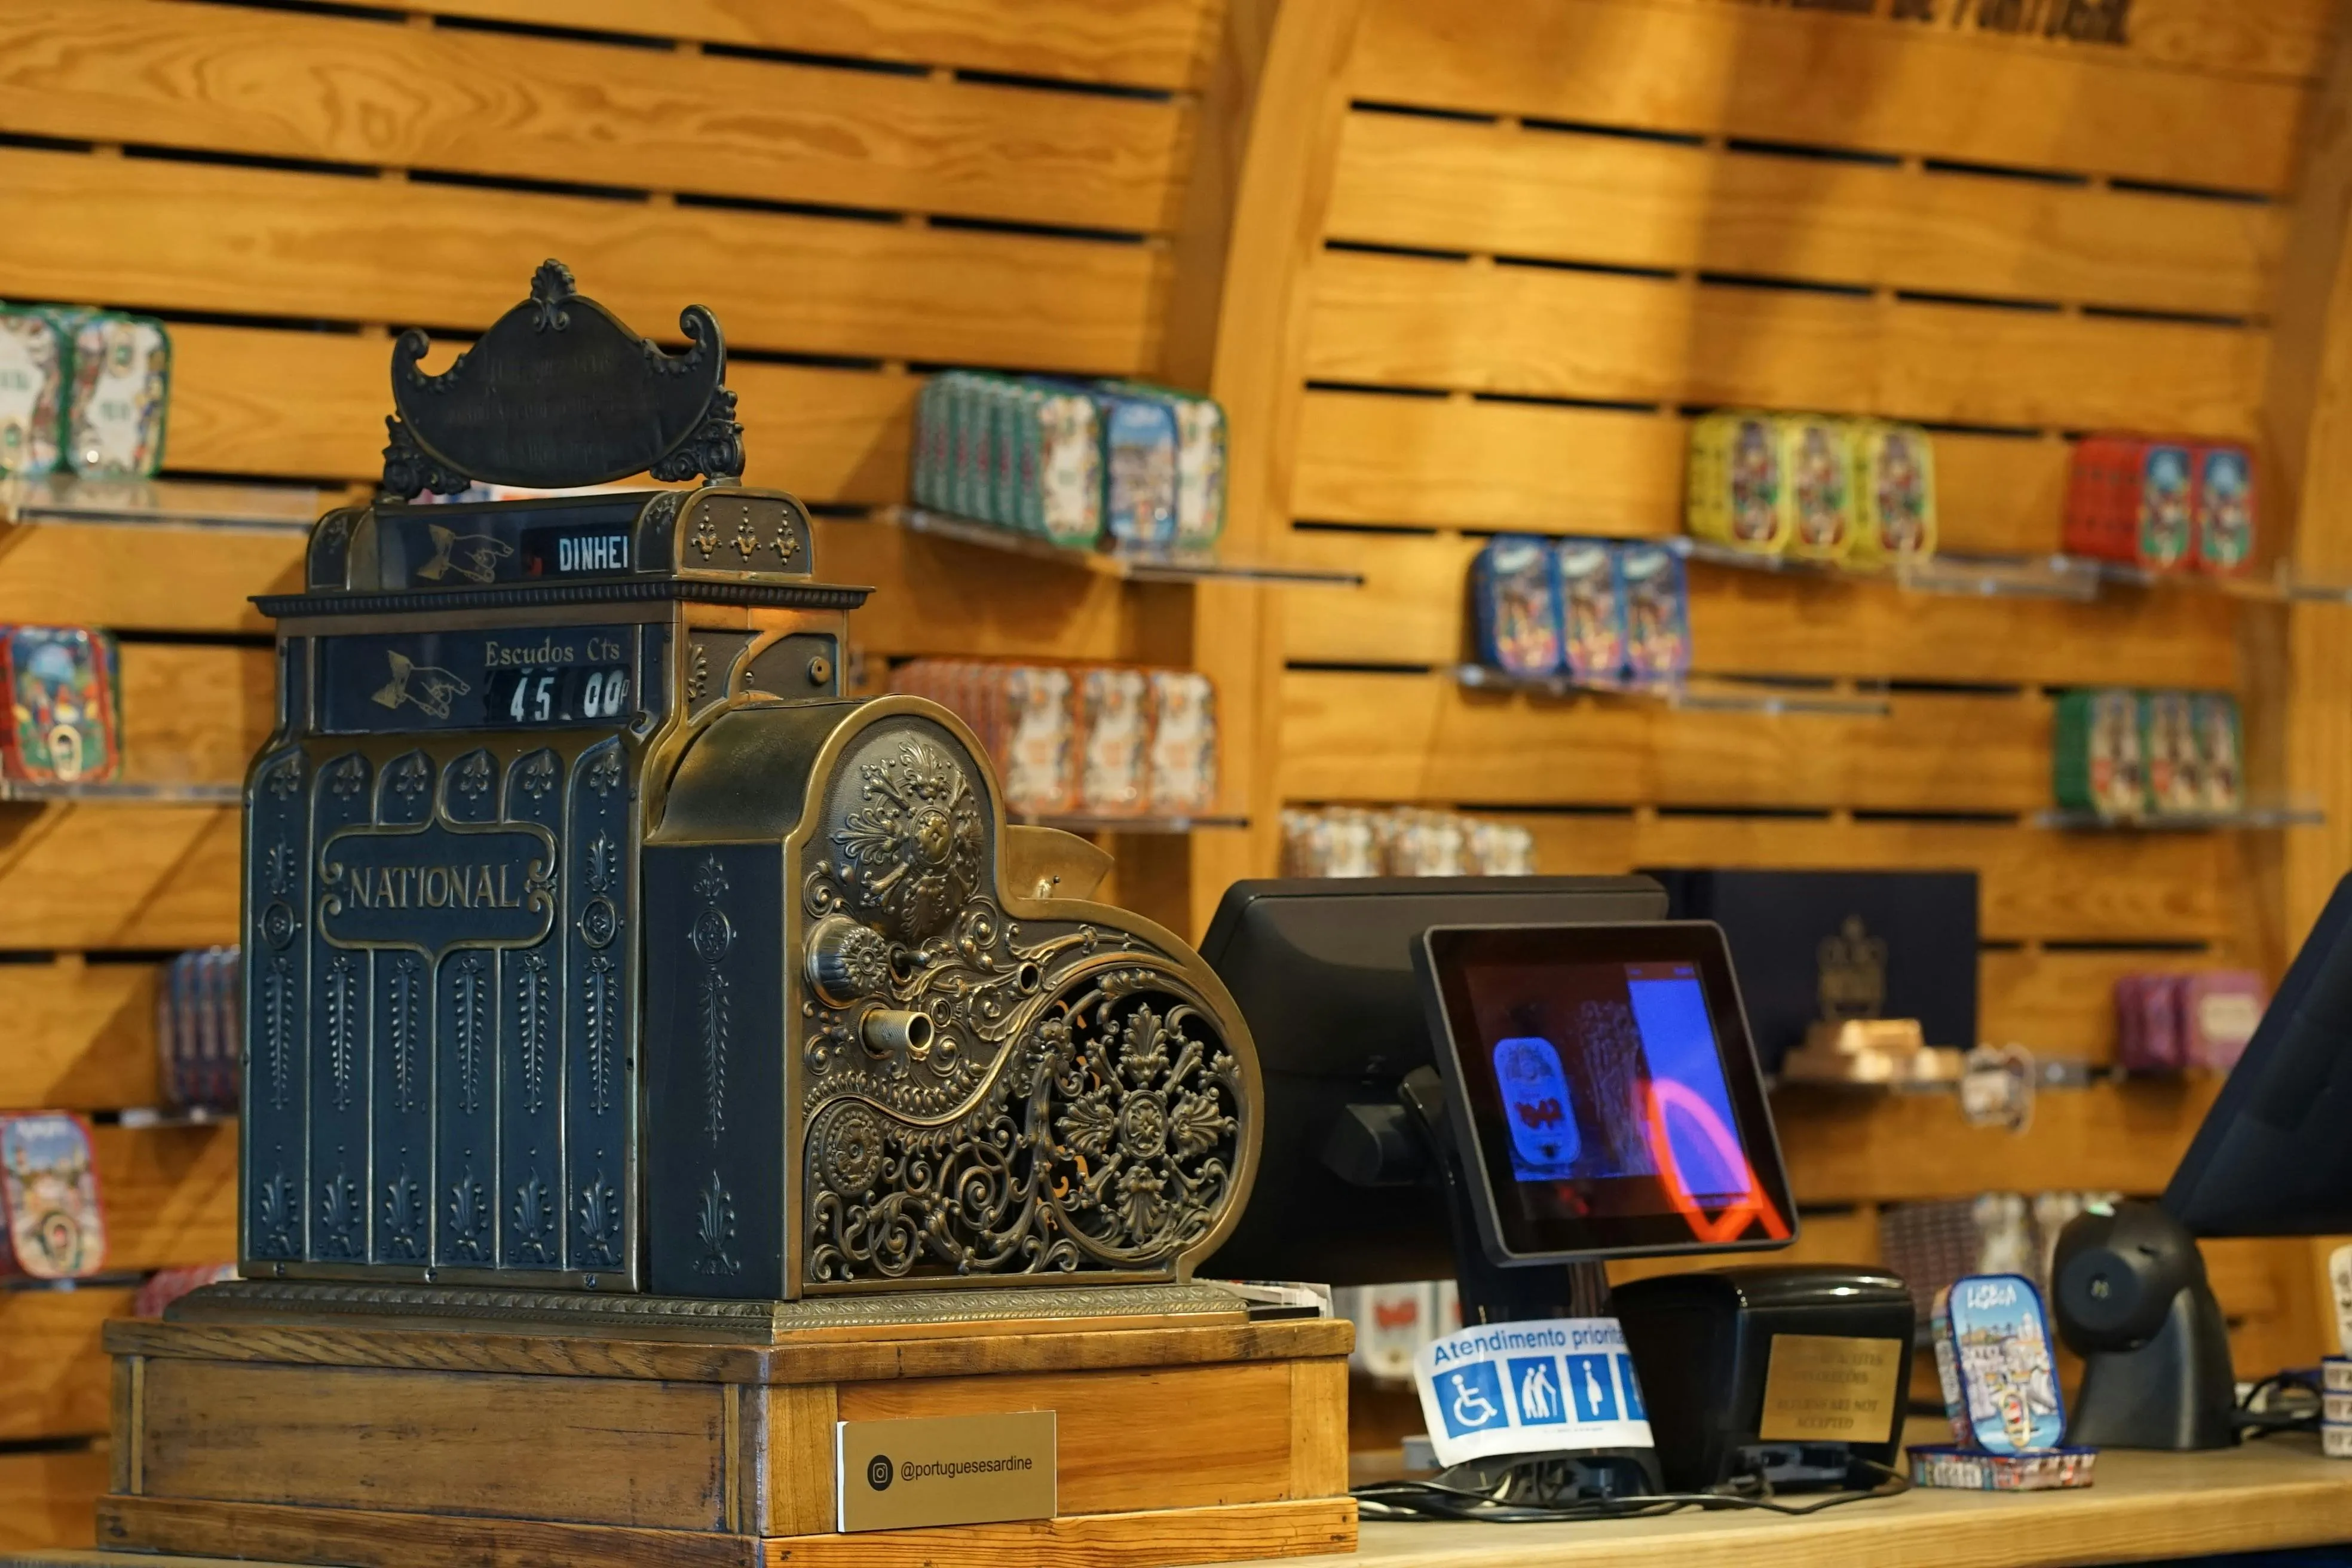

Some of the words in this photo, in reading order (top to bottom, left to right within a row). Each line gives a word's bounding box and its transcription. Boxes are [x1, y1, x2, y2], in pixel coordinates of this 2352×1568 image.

[559, 535, 629, 571] DINHEI
[485, 636, 574, 667] Escudos
[587, 637, 620, 662] Cts
[510, 676, 555, 722] 45
[350, 864, 520, 908] NATIONAL
[1435, 1328, 1566, 1365] Atendimento
[901, 1456, 1033, 1481] @portuguesesardine
